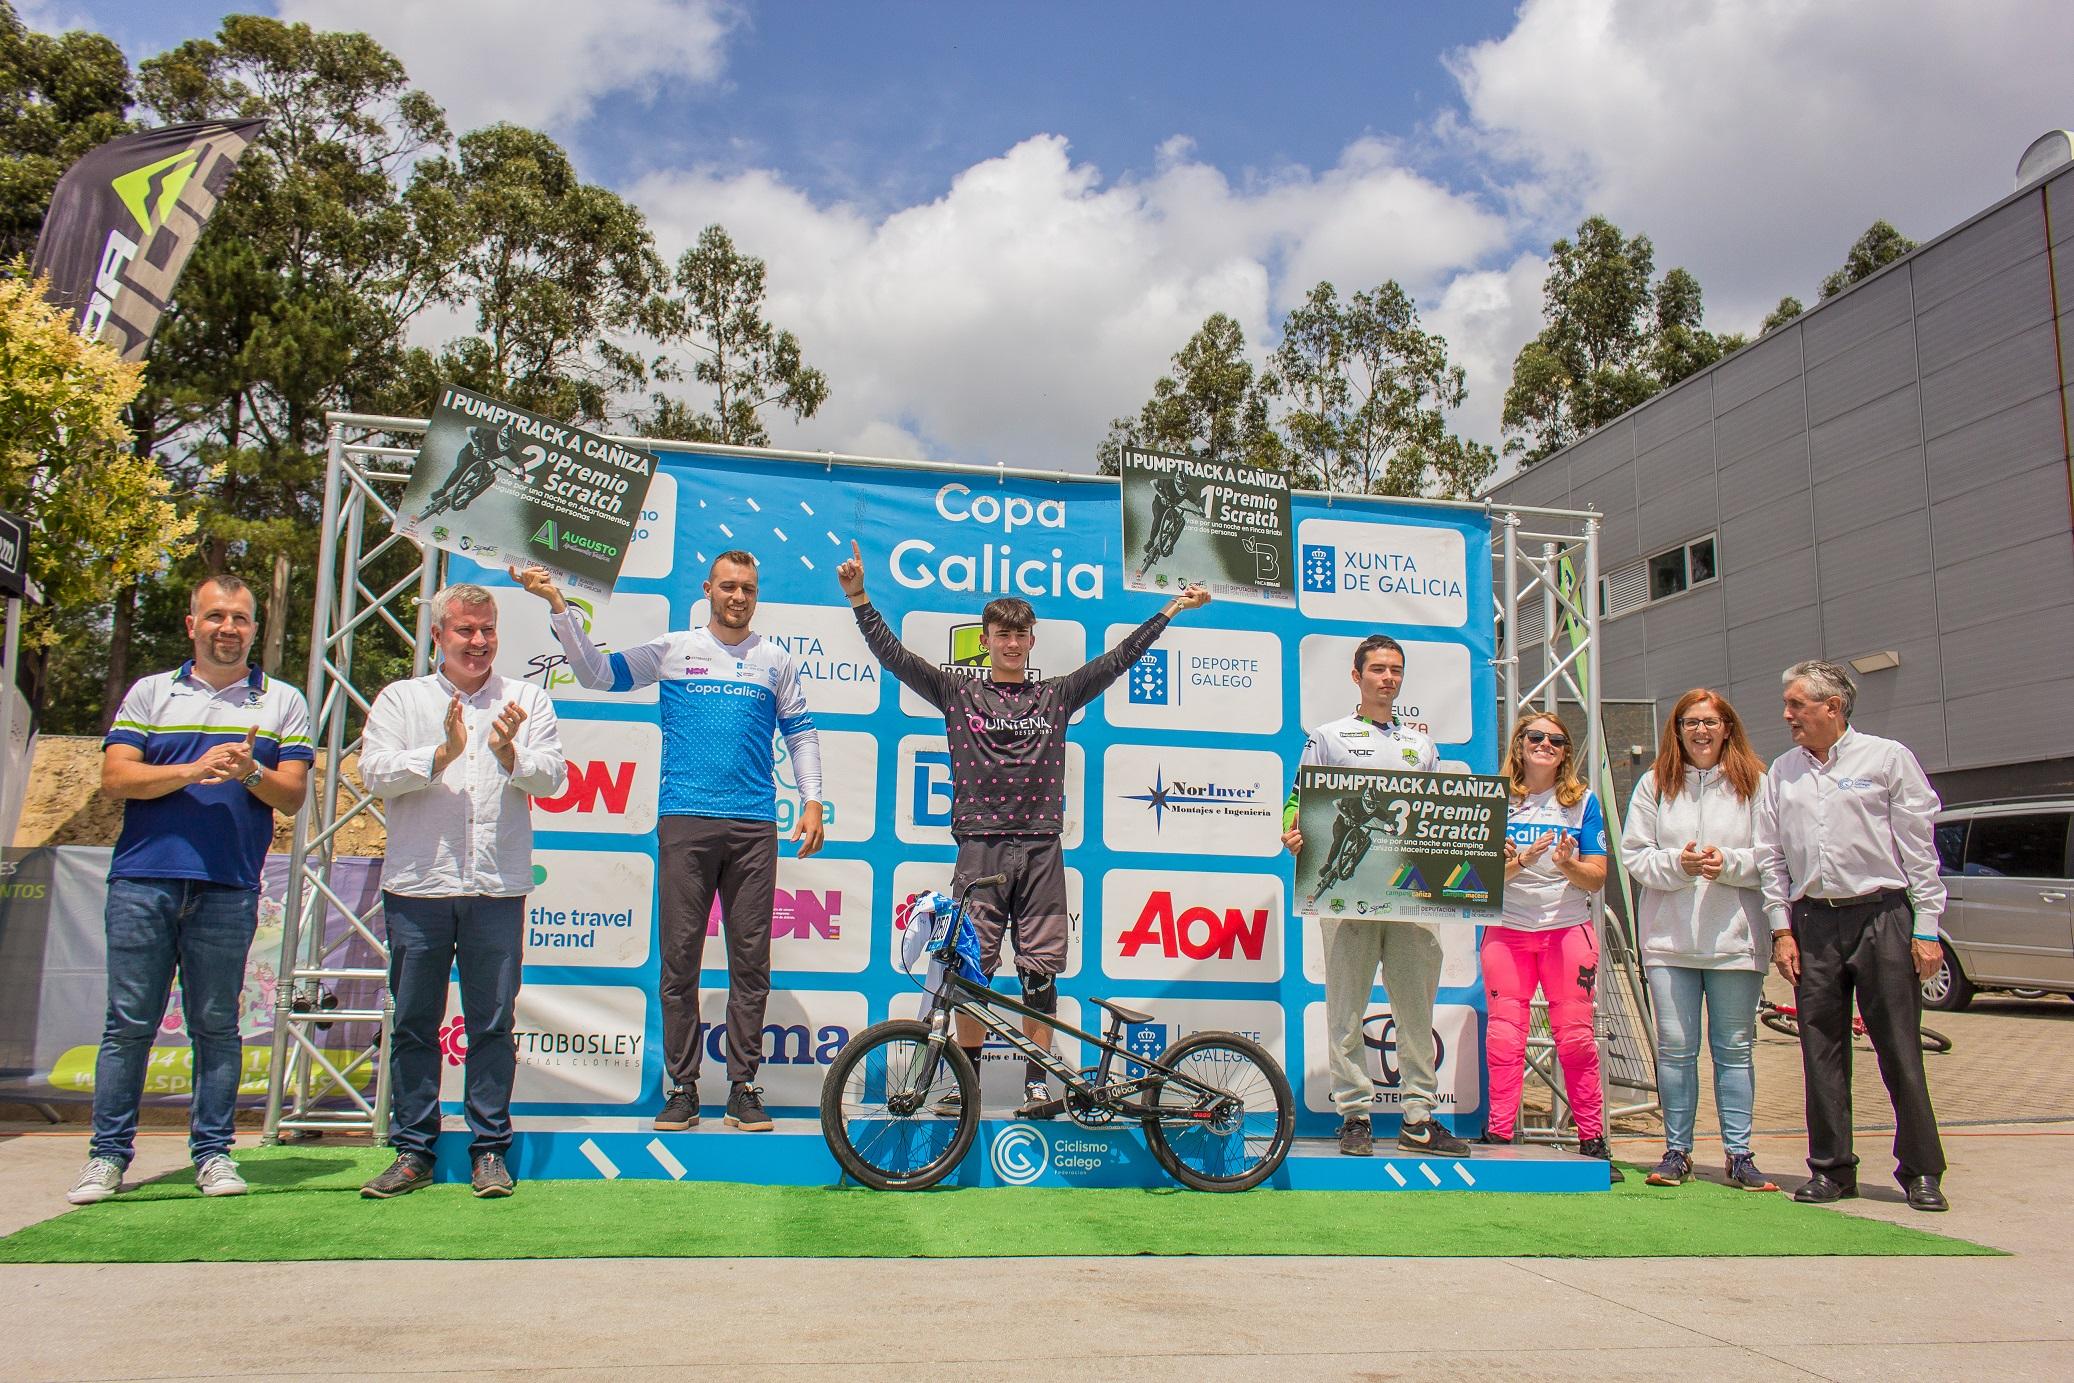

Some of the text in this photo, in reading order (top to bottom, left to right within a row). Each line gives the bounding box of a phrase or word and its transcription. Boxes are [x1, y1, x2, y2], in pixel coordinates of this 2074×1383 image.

[442, 390, 650, 476] I PUMPTRACK A CAÑIZA
[1125, 451, 1288, 491] I PUMPTRACK A CAÑIZA
[543, 473, 624, 514] Scratch
[513, 481, 528, 492] por
[528, 487, 544, 497] una
[544, 491, 568, 505] noche
[568, 500, 578, 509] en
[578, 504, 631, 528] Apartamentos
[520, 492, 540, 504] para
[540, 500, 554, 510] dos
[555, 505, 590, 522] personas
[935, 483, 1066, 533] Copa
[1219, 505, 1279, 528] Scratch
[1199, 526, 1210, 534] dos
[1210, 529, 1238, 538] personas
[1223, 522, 1241, 531] noche
[1250, 526, 1265, 534] Finca
[1266, 529, 1283, 537] Briabi
[561, 530, 617, 557] AUGUSTO
[526, 560, 564, 577] DETACIÓN
[890, 539, 1104, 600] Galicia
[1344, 551, 1417, 574] XUNTA
[1344, 573, 1463, 598] DE GALICIA
[799, 661, 876, 683] ALICIA
[1191, 656, 1259, 673] DEPORTE
[686, 682, 767, 701] Copa Galicia
[1191, 673, 1253, 689] GALEGO
[967, 714, 1052, 734] QUINTENA
[1171, 782, 1255, 798] NorInver
[1305, 772, 1506, 799] I PUMPTRACK A CAÑIZA
[1171, 805, 1214, 816] Montajes
[1224, 808, 1272, 817] Ingeniería
[1416, 820, 1490, 842] Scratch
[1400, 846, 1430, 854] Maceira
[1430, 848, 1449, 856] para
[1450, 848, 1463, 856] dos
[1464, 850, 1498, 858] personas
[1452, 841, 1484, 850] Camping
[530, 907, 633, 928] the travel
[530, 928, 595, 949] brand
[514, 1032, 642, 1055] TTOBOSLEY
[516, 1057, 640, 1068] ECIAL CLOTHES
[1054, 1140, 1108, 1152] Ciclismo
[1054, 1155, 1102, 1170] Galego
